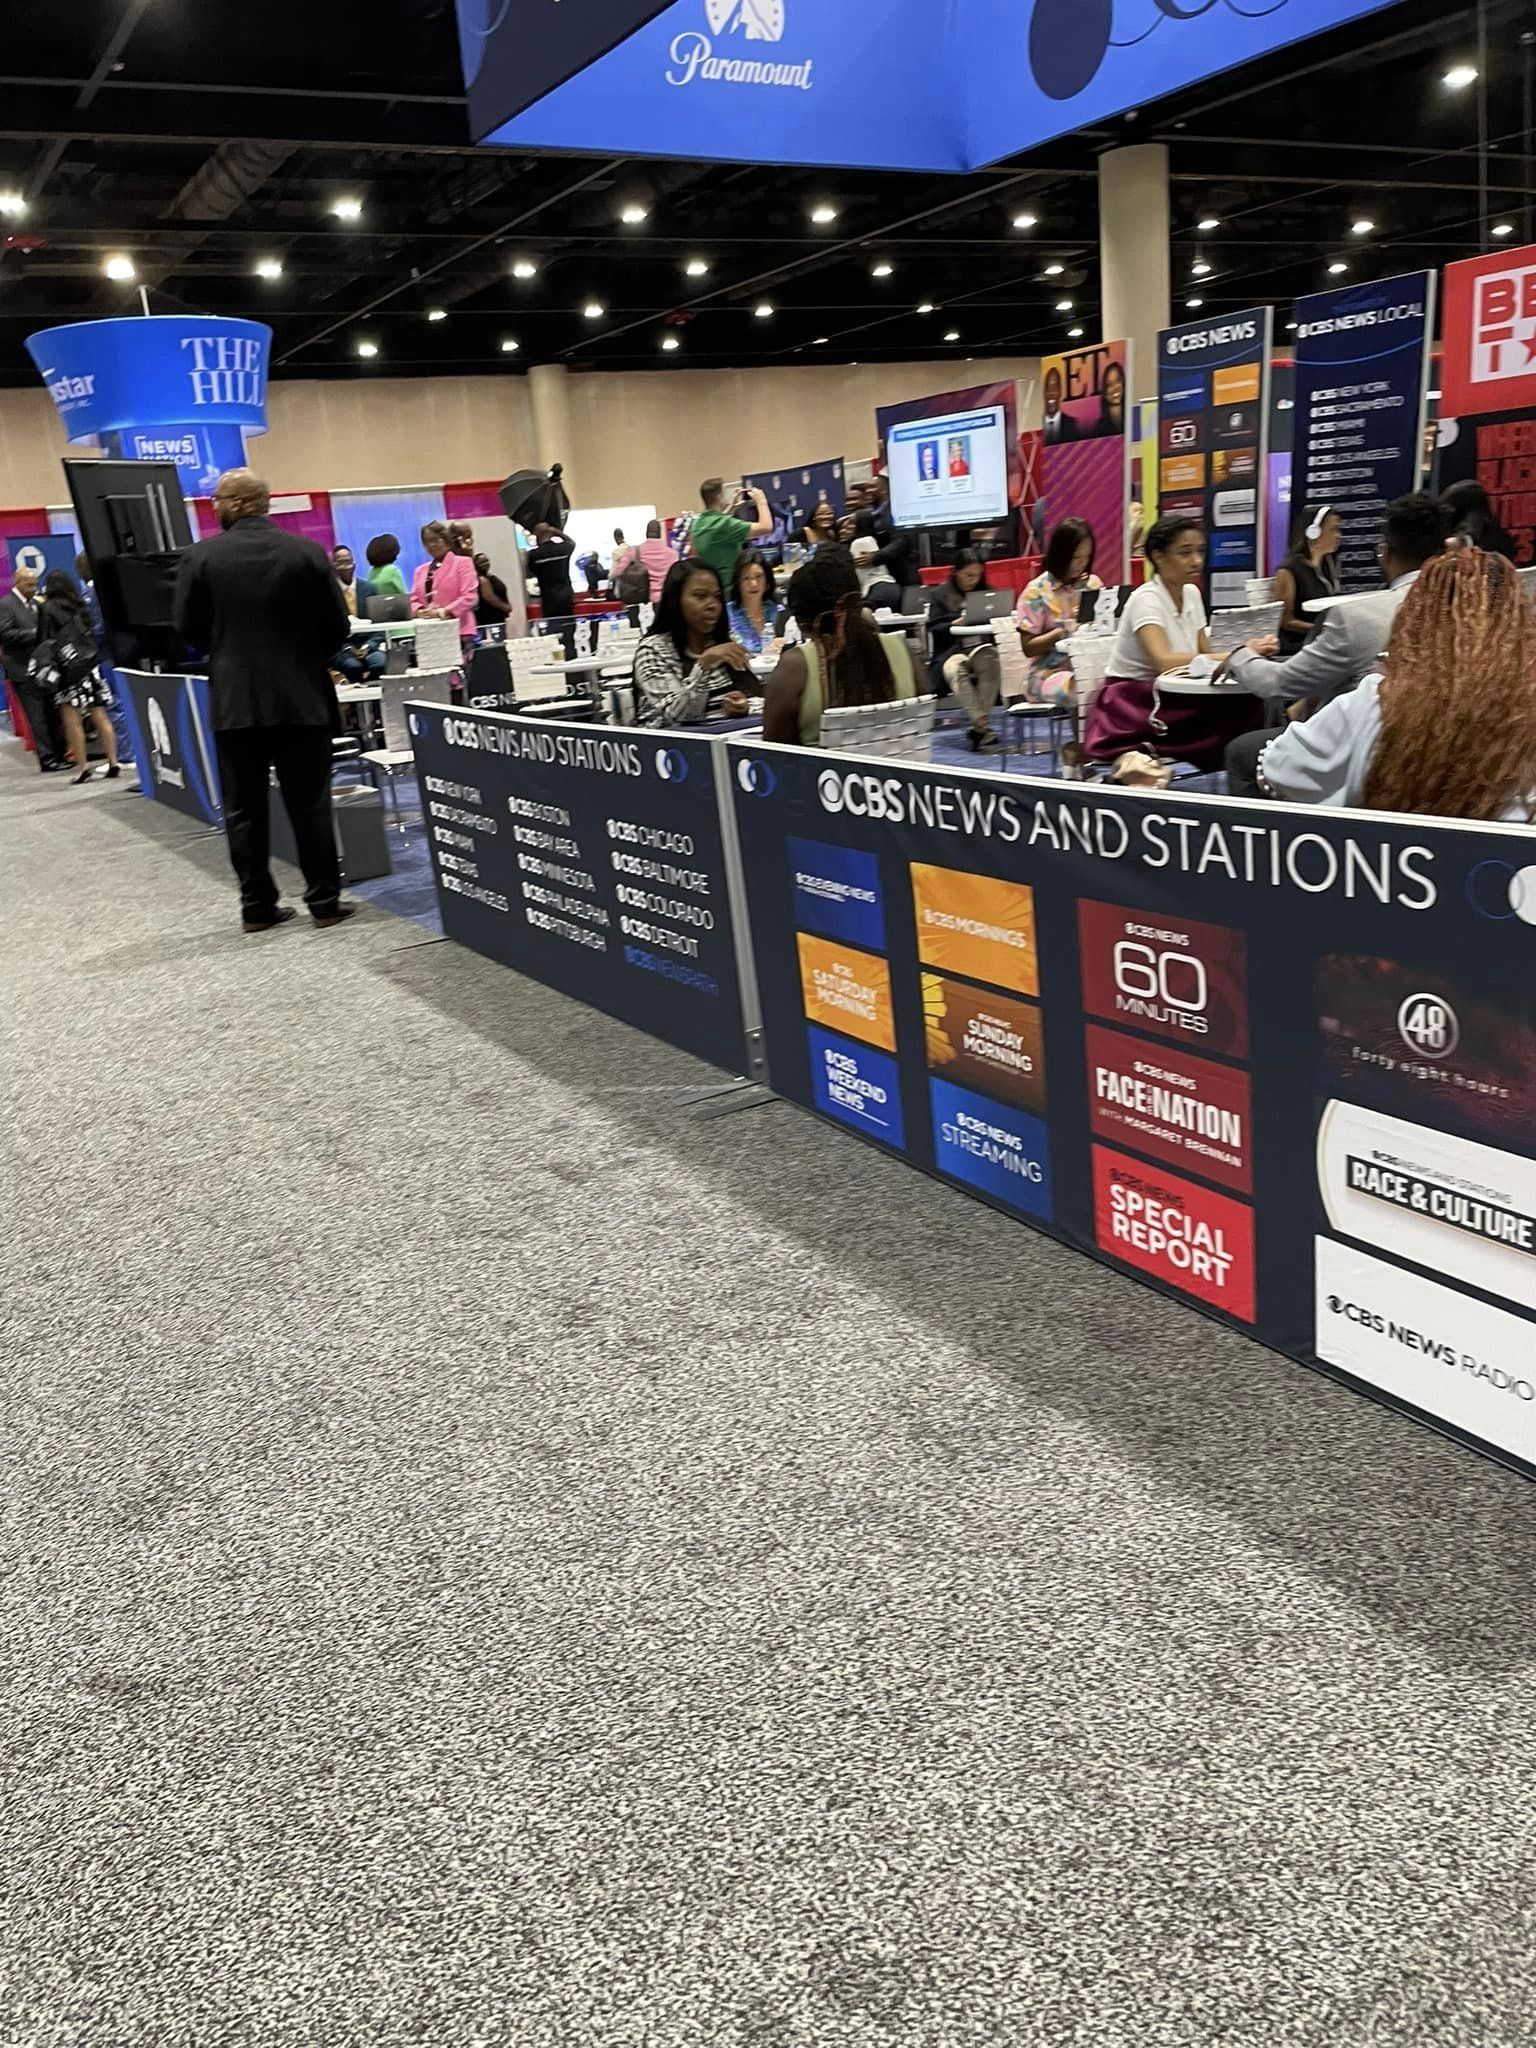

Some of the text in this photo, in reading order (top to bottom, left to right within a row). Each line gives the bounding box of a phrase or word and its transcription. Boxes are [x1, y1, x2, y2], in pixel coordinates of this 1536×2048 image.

[665, 32, 813, 89] Paramount
[1180, 320, 1257, 352] CBS NEWS
[1309, 302, 1424, 336] CBS NEWS LOCAL
[181, 337, 262, 373] THE
[188, 370, 265, 407] HILL
[1062, 347, 1109, 402] ET
[141, 440, 192, 454] NEWS
[470, 693, 499, 709] CBS
[453, 719, 642, 777] CBS NEWS AND STATIONS
[517, 798, 534, 817] CBS
[520, 827, 538, 846] CBS
[616, 821, 695, 856] CBS CHICAGO
[843, 772, 1438, 911] CBS NEWS AND STATIONS
[525, 855, 544, 875] CBS
[620, 853, 711, 895] CBS BALTIMORE
[529, 884, 547, 904] CBS
[625, 887, 715, 930] CBS COLORADO
[533, 910, 551, 930] CBS
[629, 918, 699, 958] CBS DETROIT
[933, 911, 1027, 949] CBS MORNINGS
[1134, 924, 1190, 946] CBS NEWS
[812, 969, 878, 1004] SATURDAY
[1113, 940, 1208, 1012] 60
[816, 986, 877, 1021] MORNING
[1115, 994, 1209, 1034] MINUTES
[967, 1019, 1024, 1050] SUNDAY
[1406, 1003, 1446, 1049] 48
[834, 1053, 858, 1075] CBS
[962, 1034, 1033, 1072] MORNING
[826, 1065, 887, 1104] WEEKEND
[1142, 1063, 1198, 1091] CBS NEWS
[1352, 1047, 1511, 1099] forty eight hours
[828, 1082, 865, 1110] NEWS
[1096, 1066, 1147, 1114] FACE
[1152, 1086, 1242, 1148] NATION
[965, 1116, 1023, 1151] CBS NEWS
[1124, 1115, 1183, 1144] MARGARET
[1184, 1138, 1242, 1168] BRENNAN
[941, 1123, 1042, 1183] STREAMING
[1379, 1152, 1400, 1167] CBS
[1110, 1183, 1234, 1262] SPECIAL
[1351, 1161, 1534, 1249] RACE & CULTURE
[1112, 1211, 1231, 1287] REPORT
[1344, 1303, 1535, 1401] CBS NEWS RADIO
